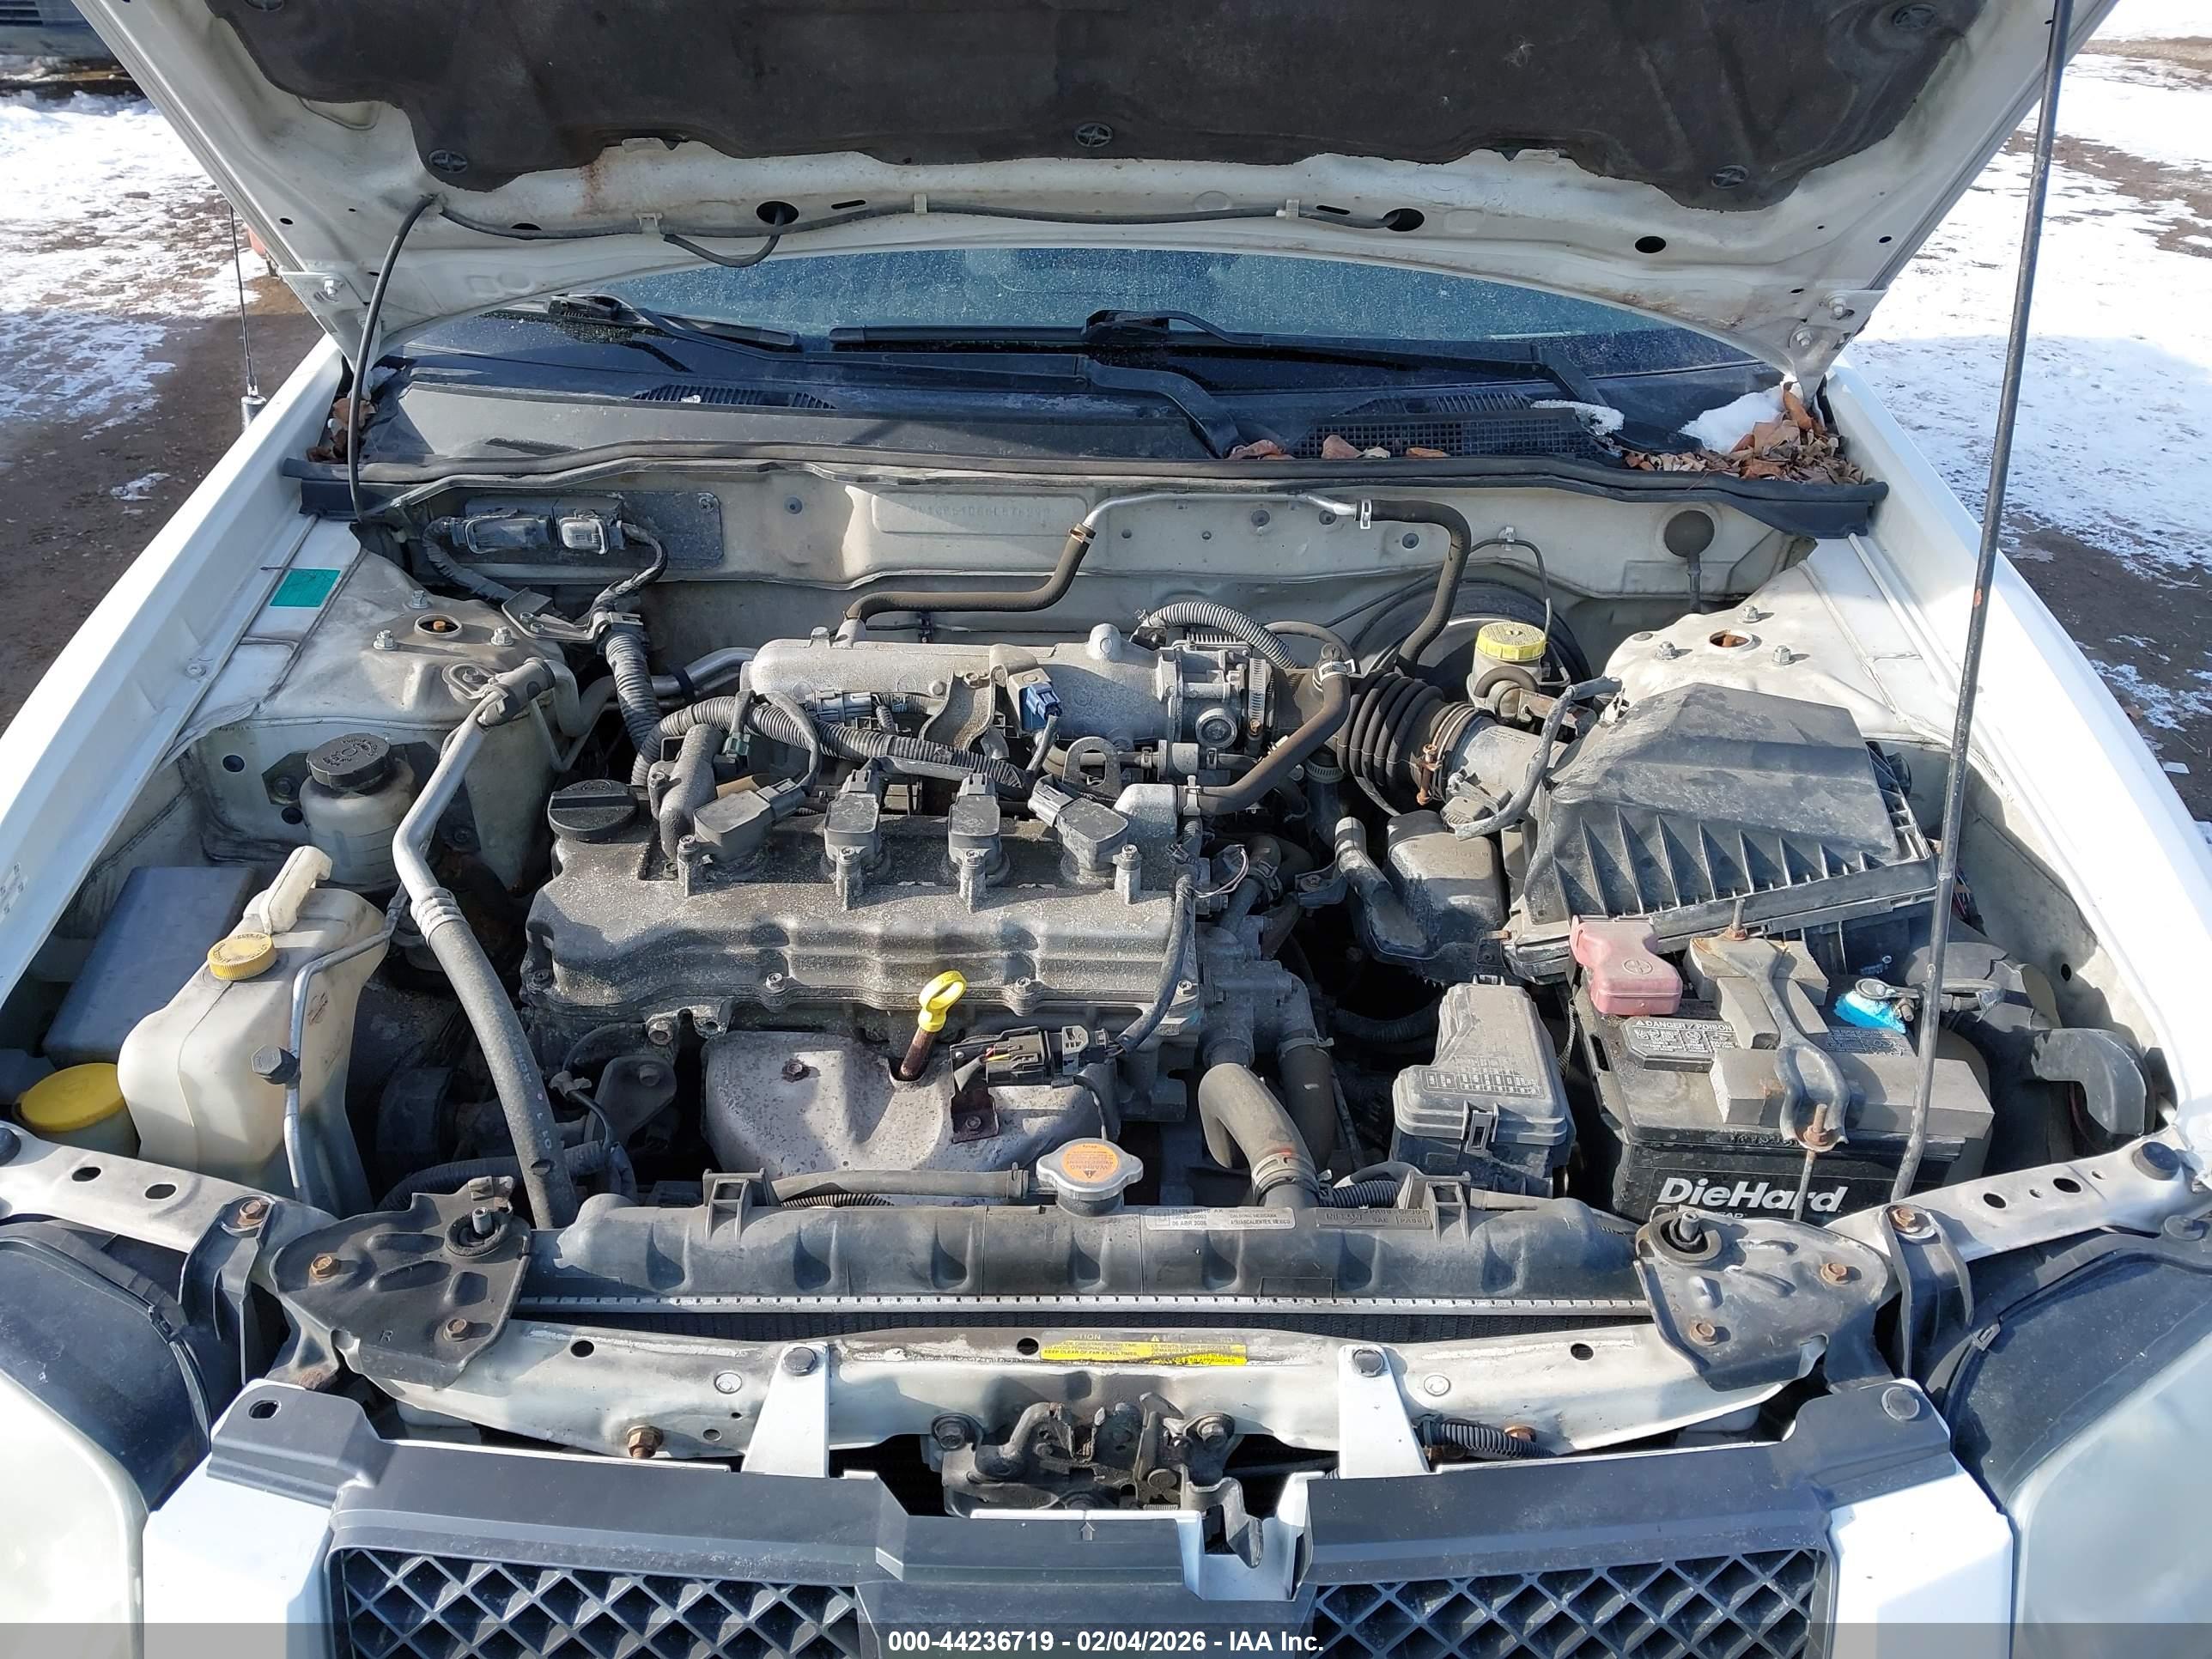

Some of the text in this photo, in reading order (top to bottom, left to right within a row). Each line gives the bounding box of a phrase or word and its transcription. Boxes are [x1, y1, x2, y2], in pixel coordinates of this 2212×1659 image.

[1645, 1020, 1686, 1029] DANGER
[1656, 1177, 1848, 1212] DieHard
[379, 1330, 393, 1342] R
